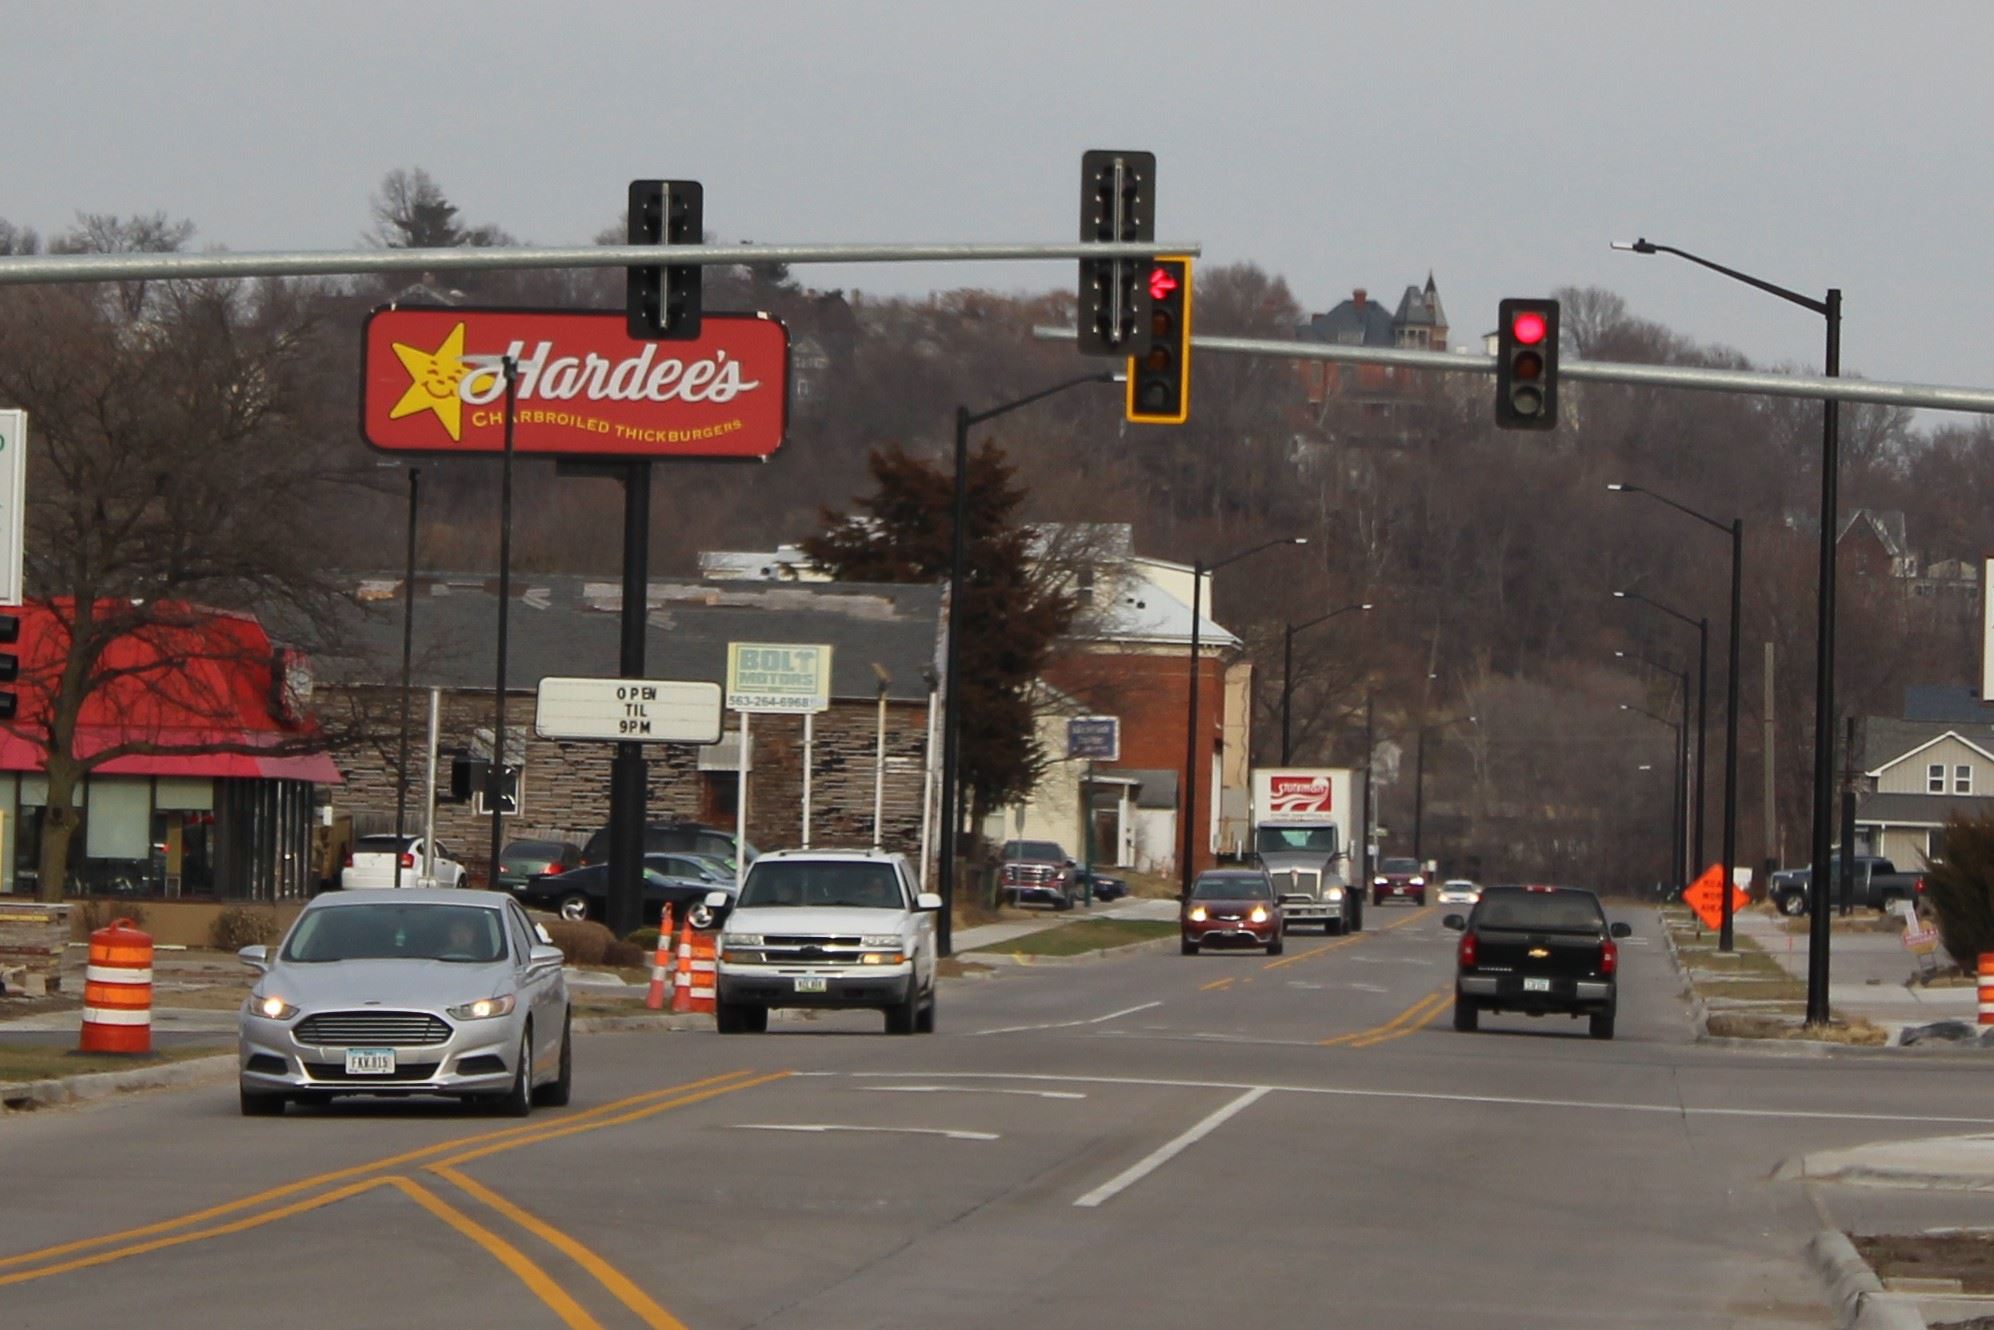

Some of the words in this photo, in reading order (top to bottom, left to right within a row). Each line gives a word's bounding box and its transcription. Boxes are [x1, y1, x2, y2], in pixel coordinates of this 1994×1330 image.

[456, 341, 759, 404] Hardee's
[471, 410, 610, 433] CHRBROILED
[615, 419, 742, 443] THICKBURGERS
[740, 650, 815, 673] BOLT
[616, 687, 657, 700] OPEN
[624, 703, 648, 717] TIL
[619, 720, 651, 734] 9PM
